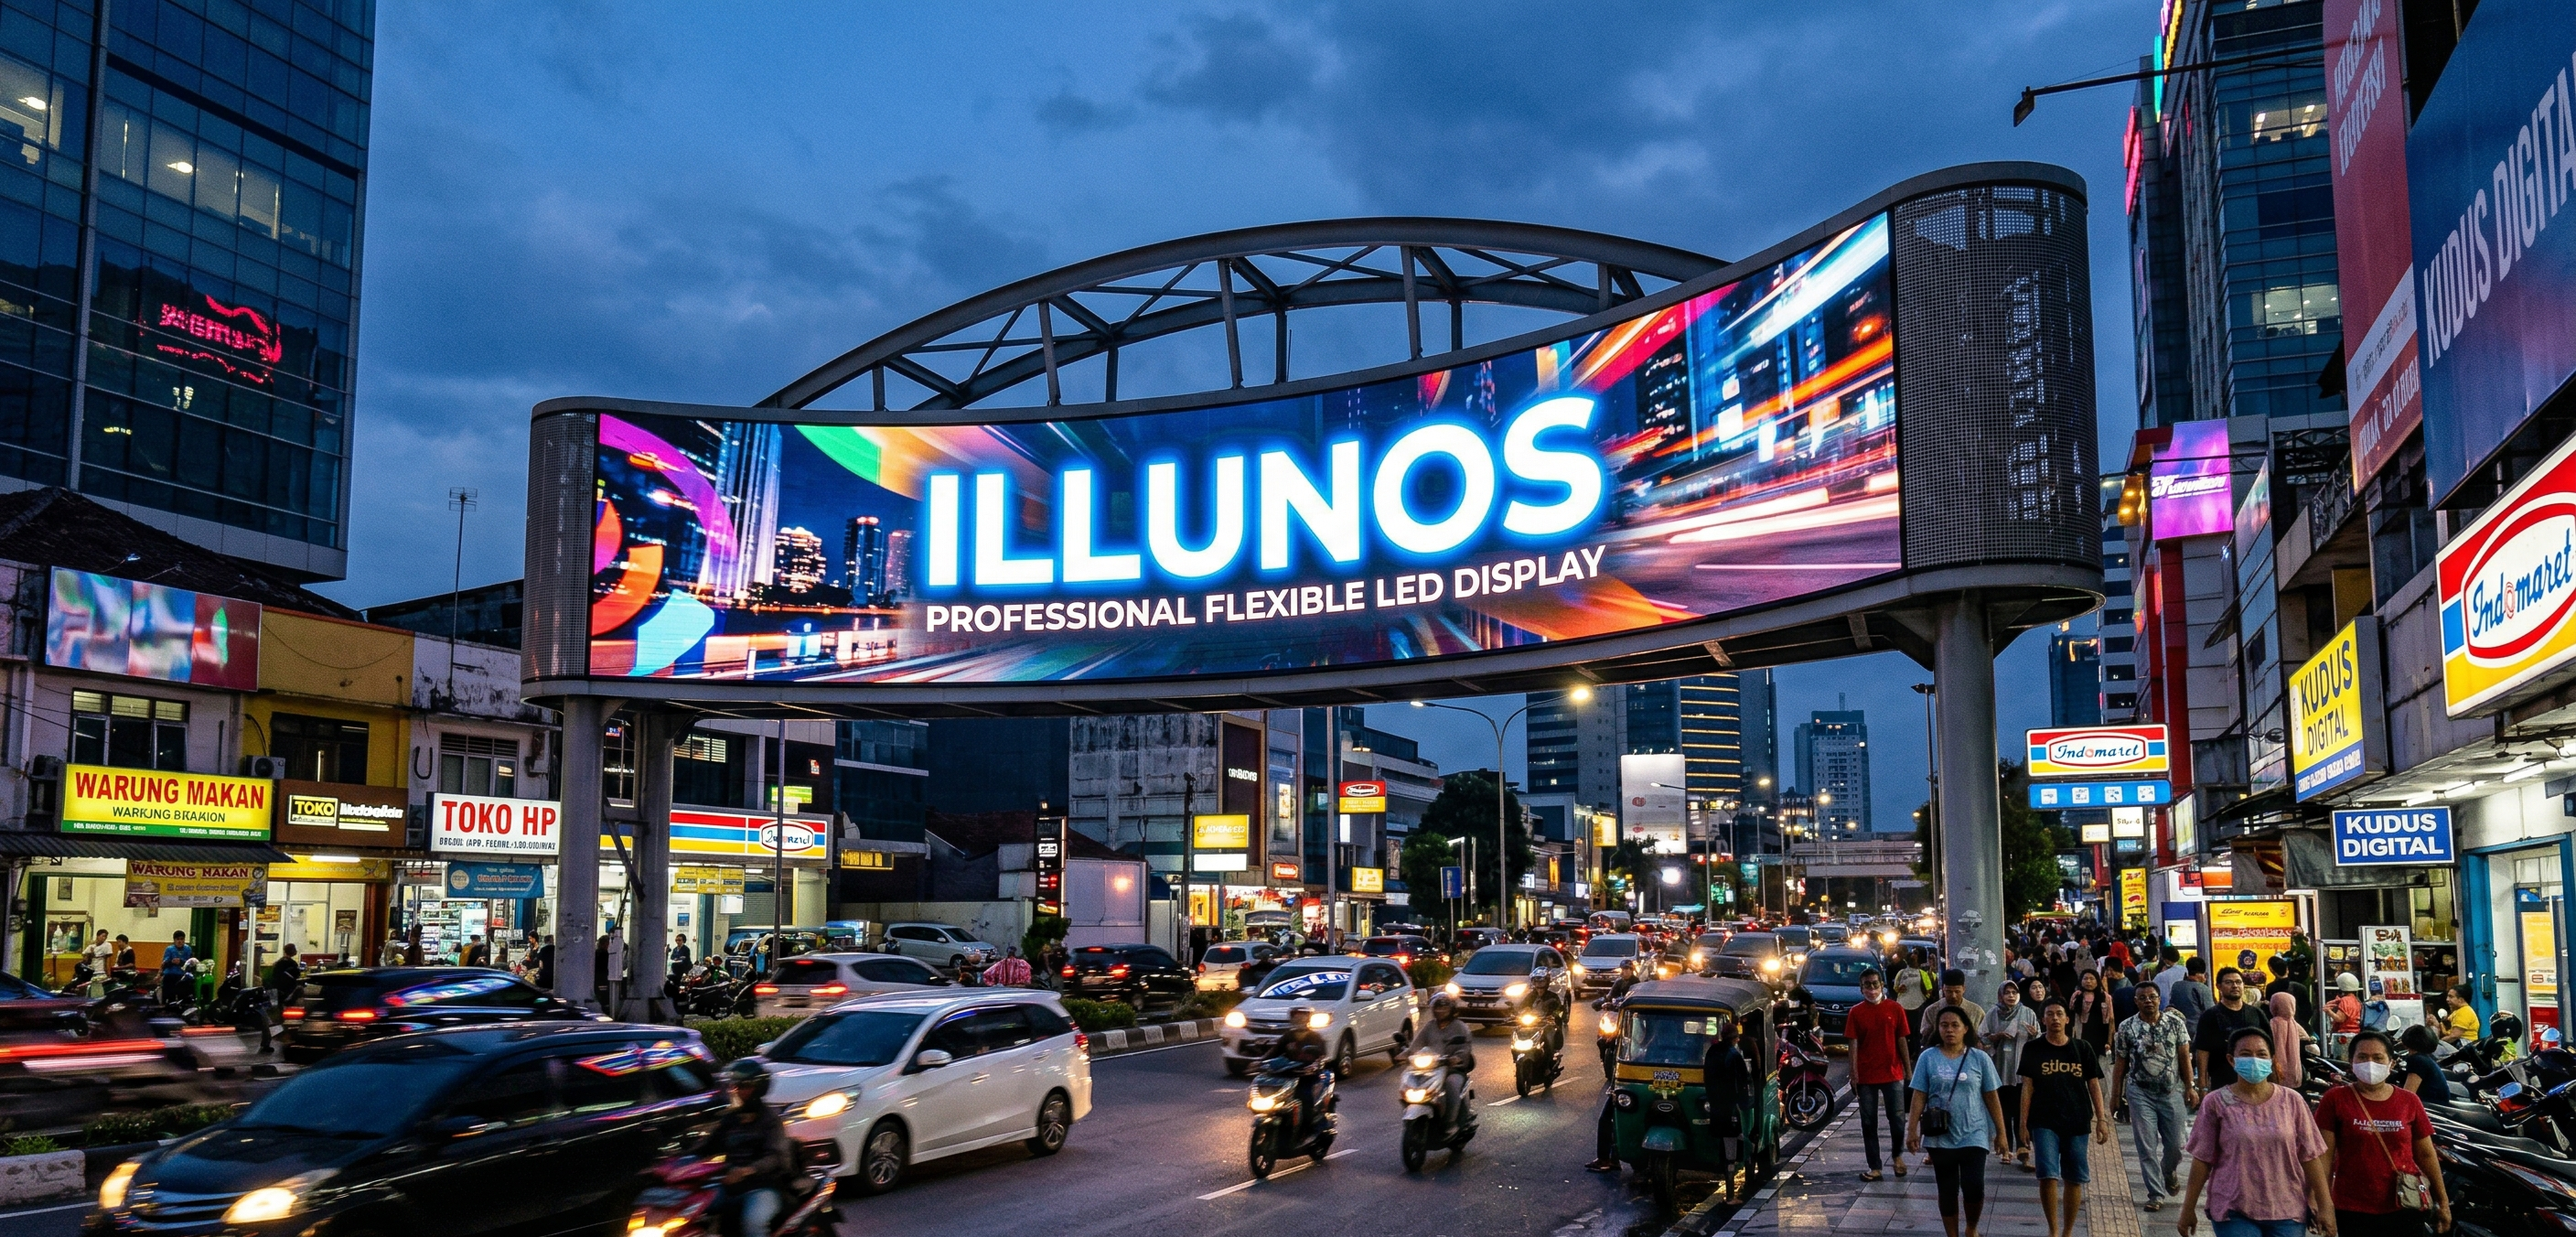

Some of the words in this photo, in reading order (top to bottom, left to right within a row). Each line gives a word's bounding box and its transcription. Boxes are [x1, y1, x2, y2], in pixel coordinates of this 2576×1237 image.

[2424, 188, 2492, 369] KUDUS
[2493, 50, 2576, 283] DIGITA
[928, 397, 1603, 586] ILLUNOS
[927, 597, 1196, 633] PROFESSIONAL
[1206, 581, 1366, 624] FLEXIBLE
[1377, 573, 1444, 608] LED
[1454, 545, 1606, 599] DISPLAY
[2473, 528, 2573, 638] Indomaret
[2301, 640, 2353, 720] KUDUS
[2307, 704, 2349, 757] DIGITAL
[75, 771, 179, 804] WARUNG
[187, 780, 264, 810] MAKAN
[295, 801, 335, 816] TOKO
[441, 801, 512, 834] TOKO
[522, 806, 556, 835] HP
[2345, 813, 2437, 834] KUDUS
[2343, 836, 2444, 857] DIGITAL
[130, 863, 197, 878] WARUNG
